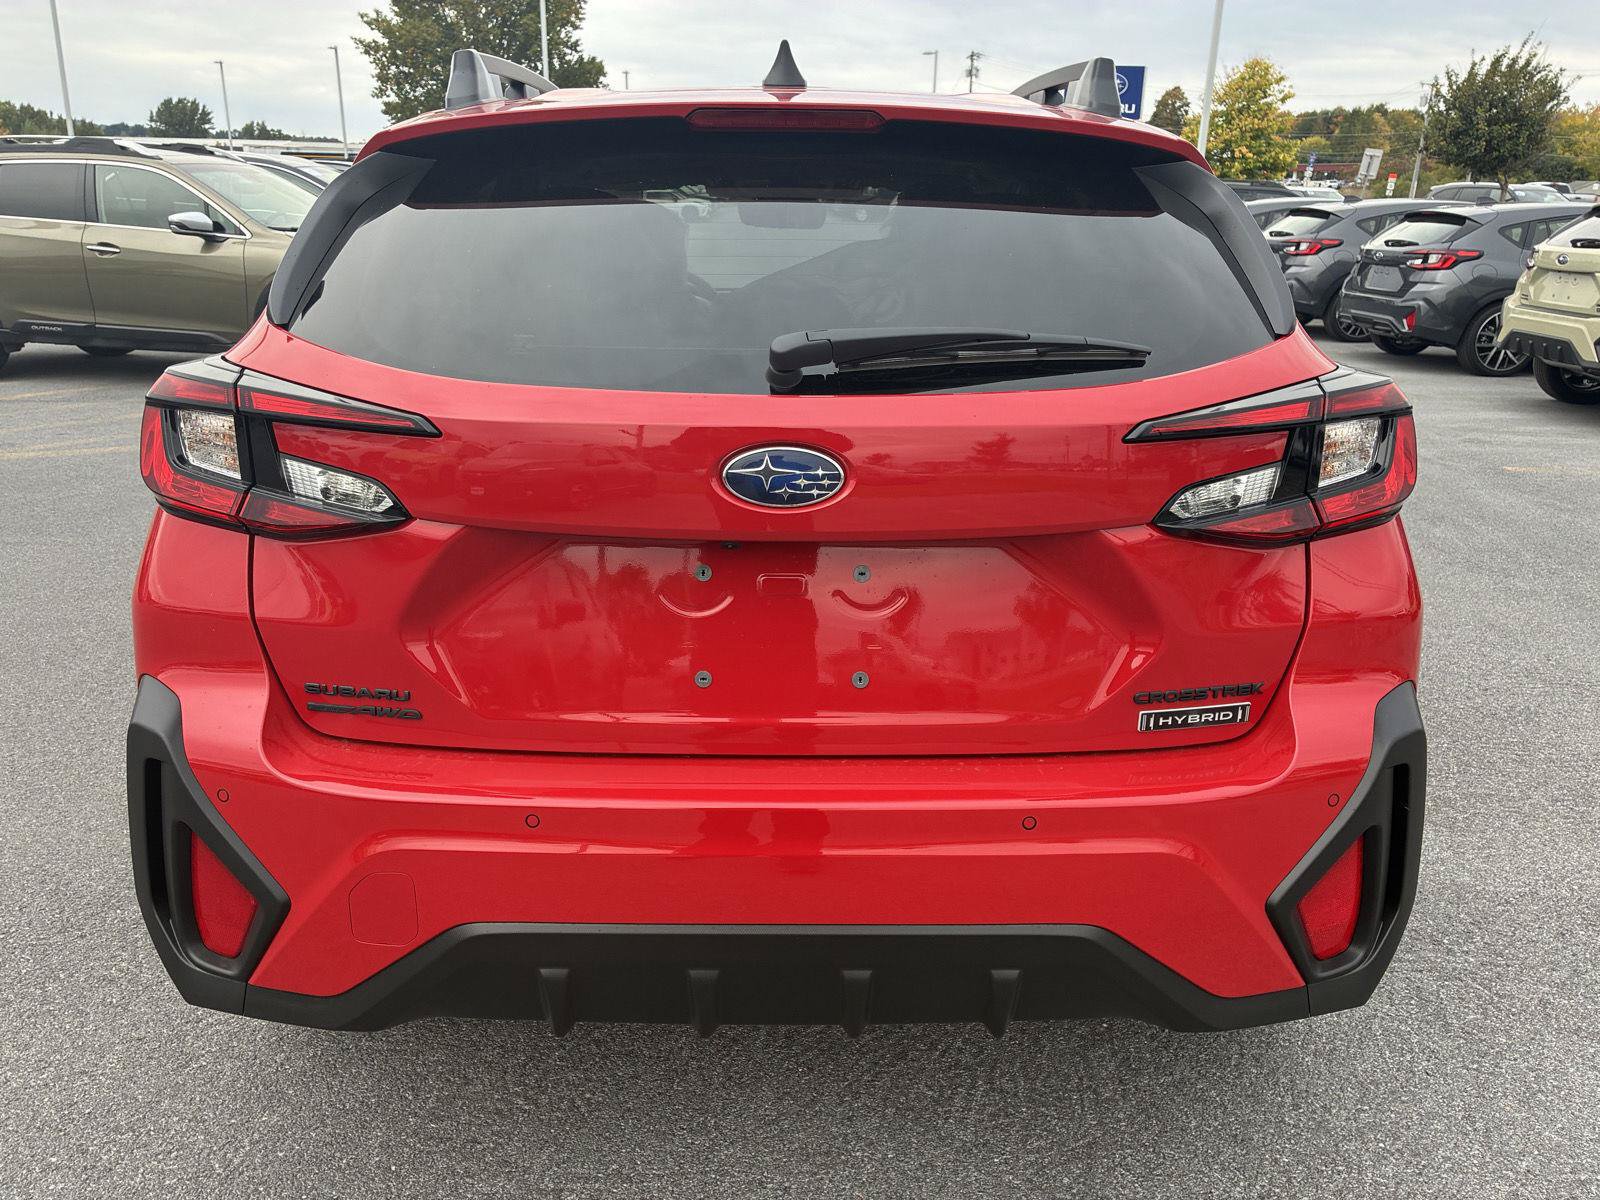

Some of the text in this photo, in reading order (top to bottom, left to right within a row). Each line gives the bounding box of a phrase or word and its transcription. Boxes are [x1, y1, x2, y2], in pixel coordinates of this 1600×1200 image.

[303, 682, 411, 702] SUBARU
[1133, 681, 1264, 705] CROSSTREK
[351, 705, 423, 720] AWD
[1159, 711, 1234, 726] HYBRID
